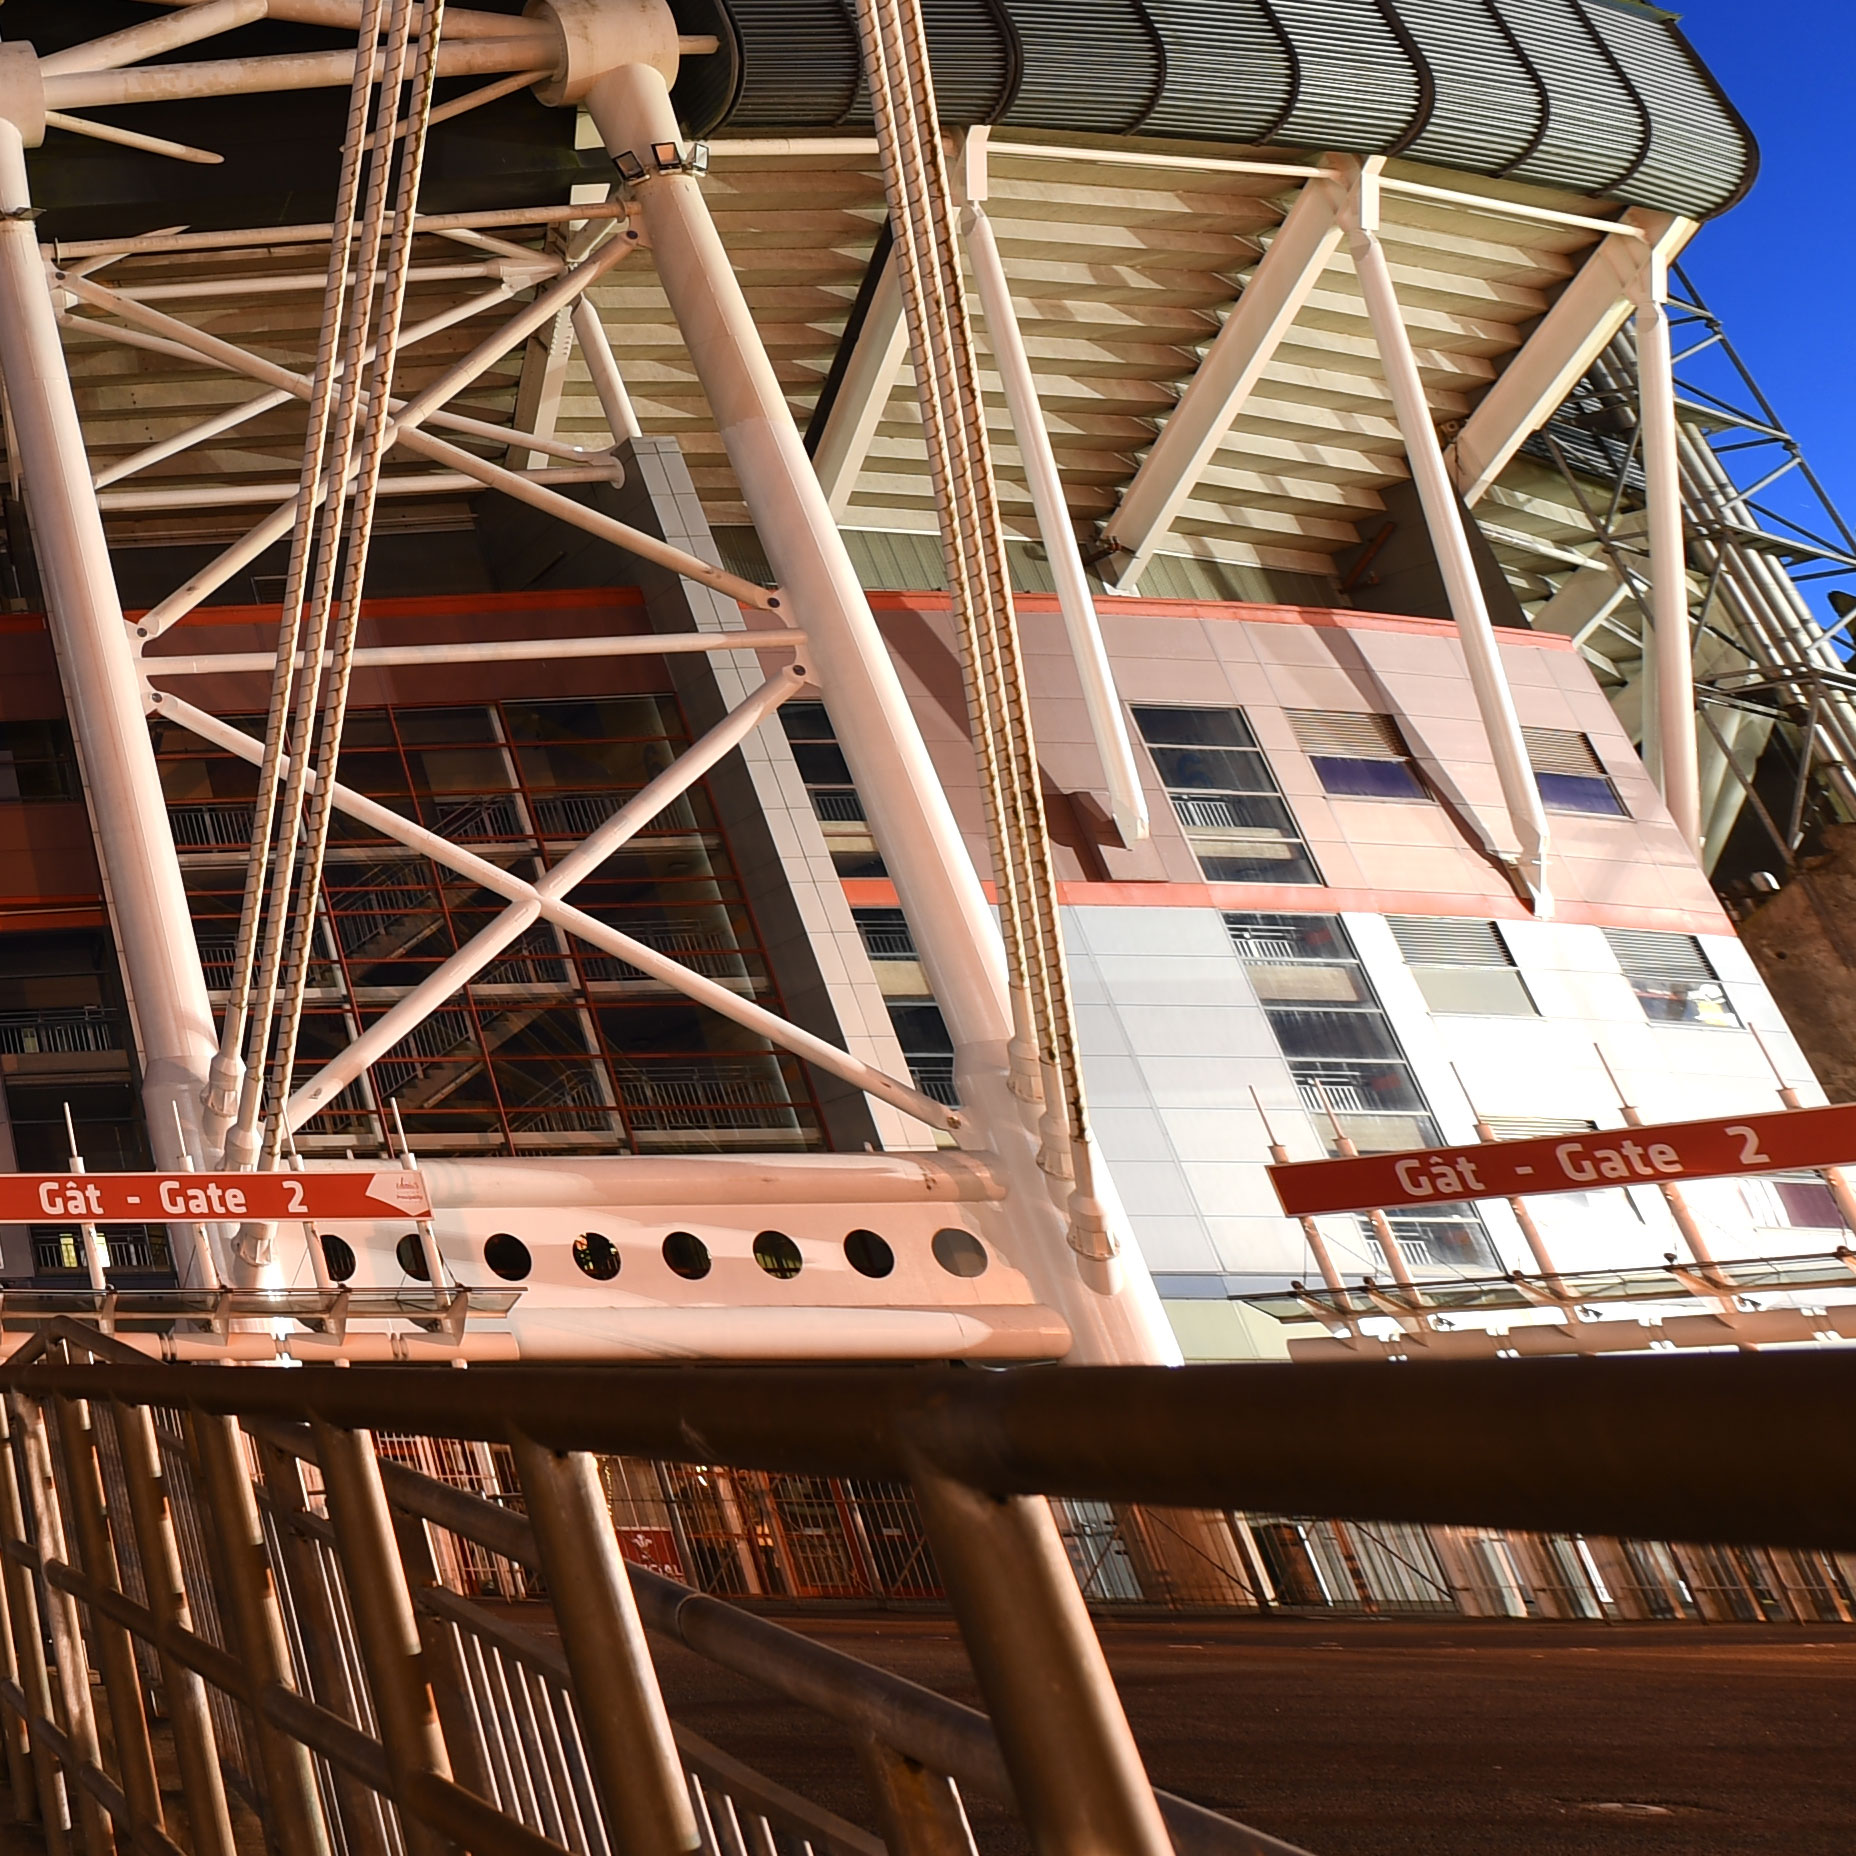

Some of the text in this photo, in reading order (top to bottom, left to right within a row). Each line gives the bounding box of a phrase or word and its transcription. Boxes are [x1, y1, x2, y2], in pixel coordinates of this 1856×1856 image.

[1394, 1155, 1487, 1197] Gât
[1555, 1139, 1684, 1182] Gate
[1724, 1125, 1771, 1165] 2
[38, 1180, 105, 1215] Gât
[159, 1180, 248, 1214] Gate
[281, 1180, 309, 1213] 2
